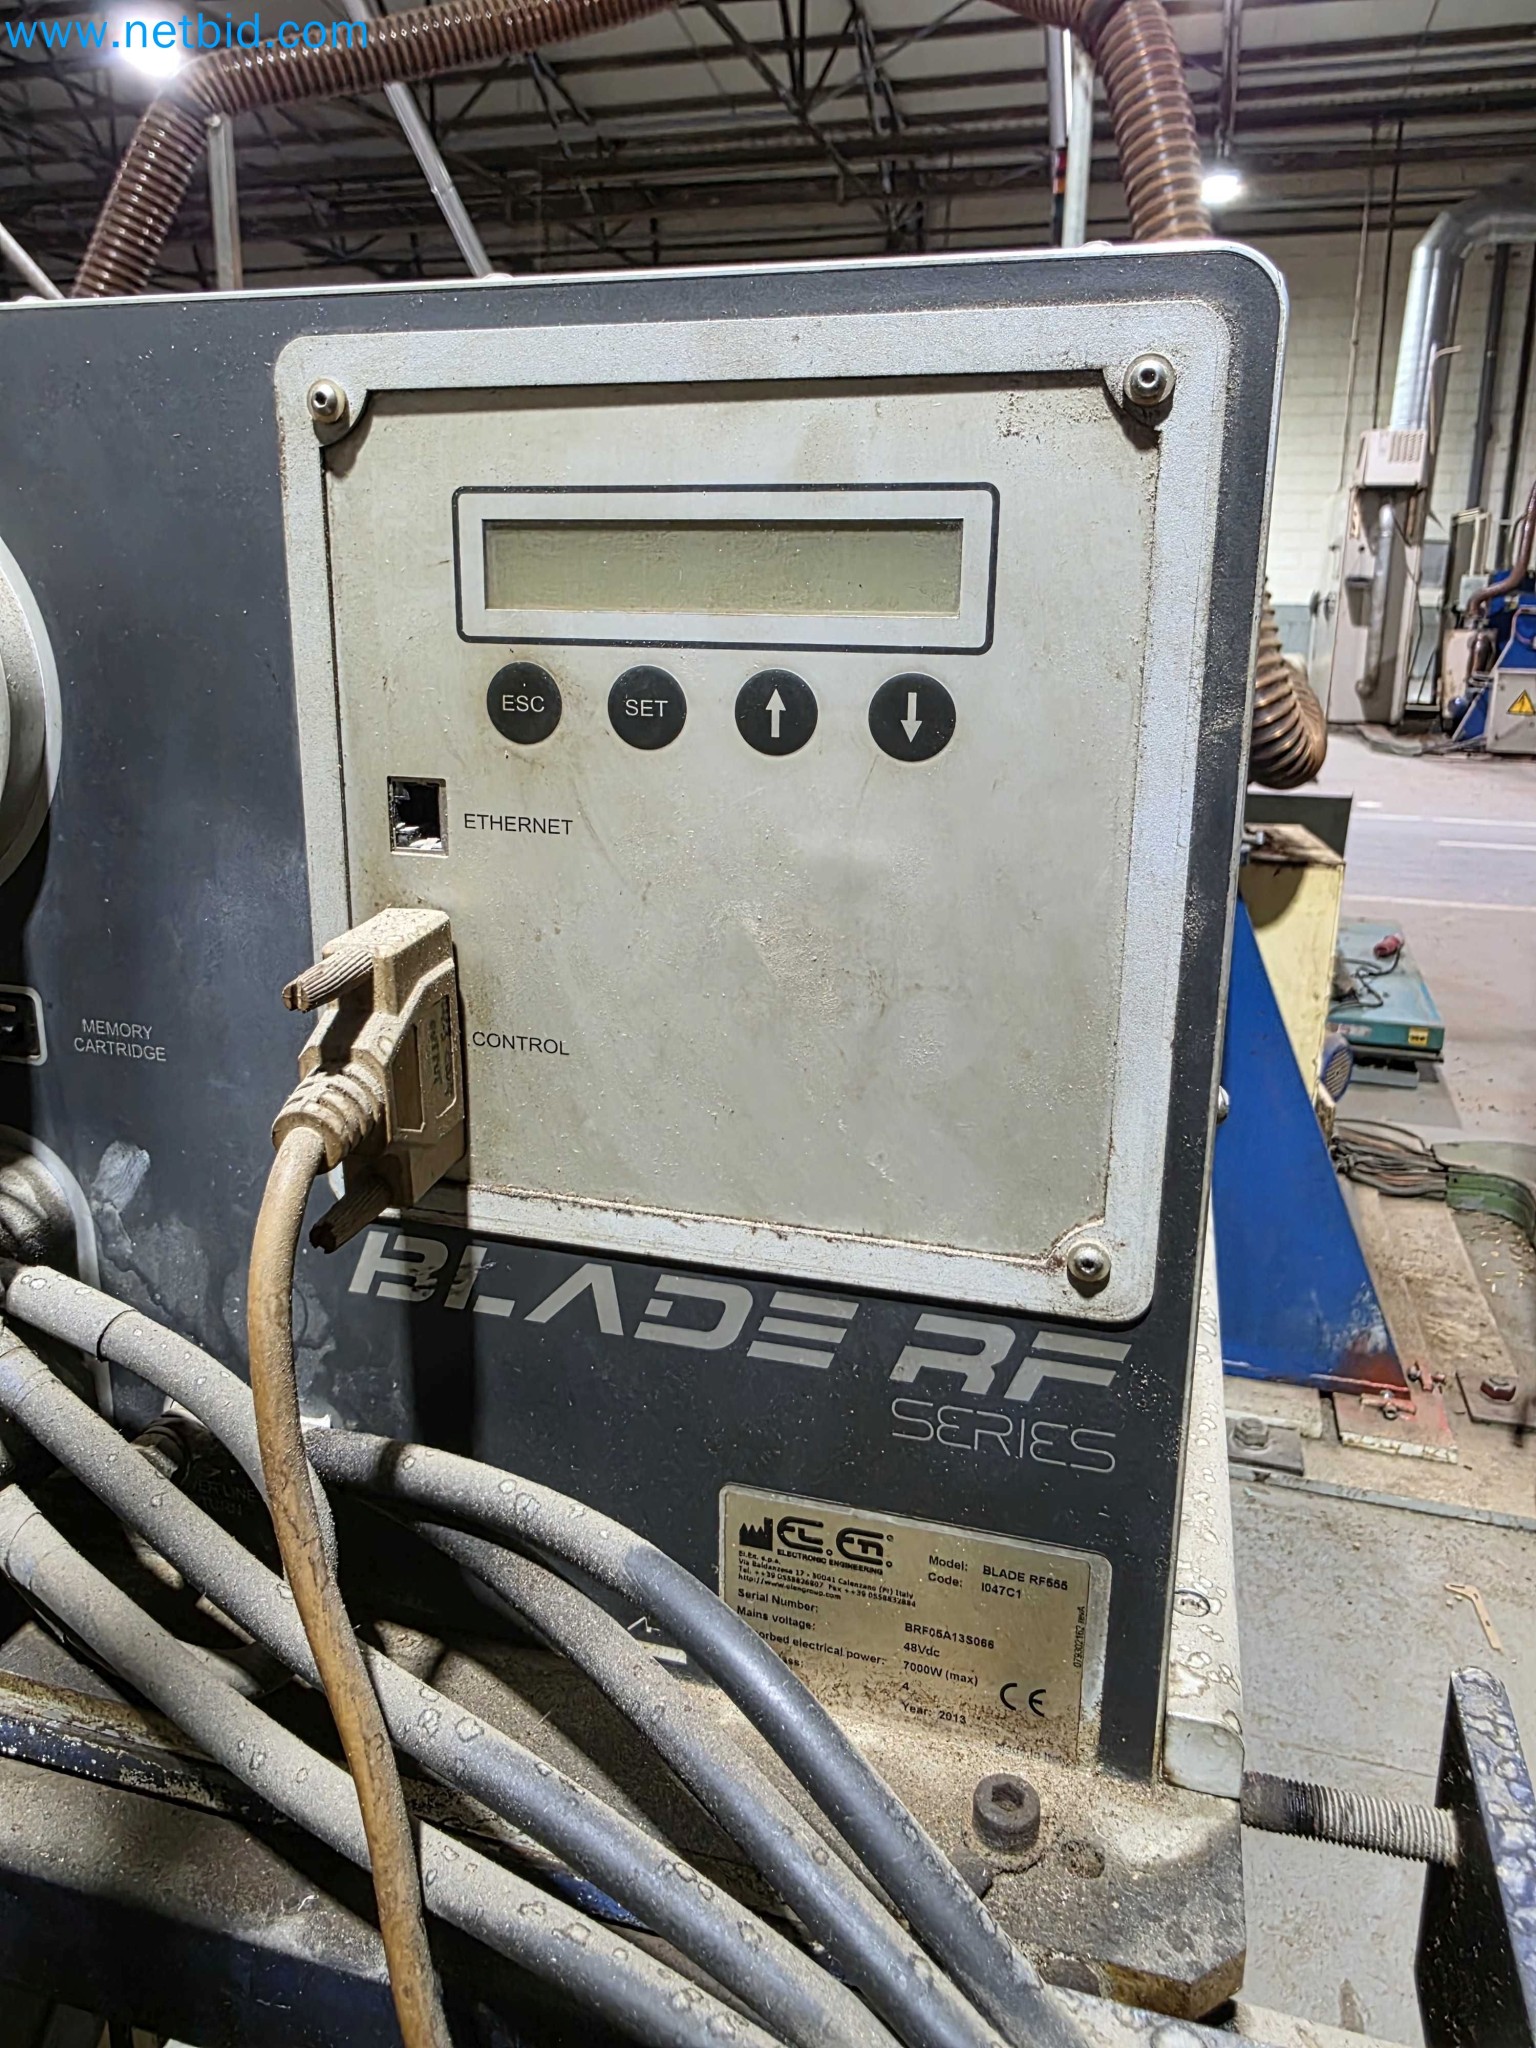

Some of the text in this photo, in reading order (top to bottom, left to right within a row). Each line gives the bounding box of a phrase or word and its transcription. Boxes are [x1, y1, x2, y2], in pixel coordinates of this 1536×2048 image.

[501, 694, 545, 714] ESC
[624, 698, 669, 718] SET
[463, 812, 574, 836] ETHERNET
[82, 1018, 153, 1040] MEMORY
[74, 1037, 167, 1062] CARTRIDGE
[471, 1031, 571, 1056] CONTROL
[348, 1229, 1132, 1402] BLADE RF
[891, 1397, 1118, 1475] SERIES
[777, 1548, 884, 1576] ELECTRONIC ENGINEERING
[928, 1555, 969, 1572] Model:
[982, 1564, 1026, 1583] BLADE
[738, 1558, 750, 1567] Via
[795, 1568, 805, 1577] 17
[895, 1589, 914, 1600] Italy
[928, 1572, 964, 1588] Code:
[737, 1588, 819, 1614] Serial Number:
[736, 1605, 816, 1631] Mains voltage:
[792, 1636, 844, 1657] electrical
[845, 1650, 886, 1666] power:
[903, 1642, 941, 1658] 48Vdc
[903, 1661, 979, 1687] 7000W (max)
[901, 1701, 967, 1725] Year: 2013
[999, 1682, 1047, 1718] CE
